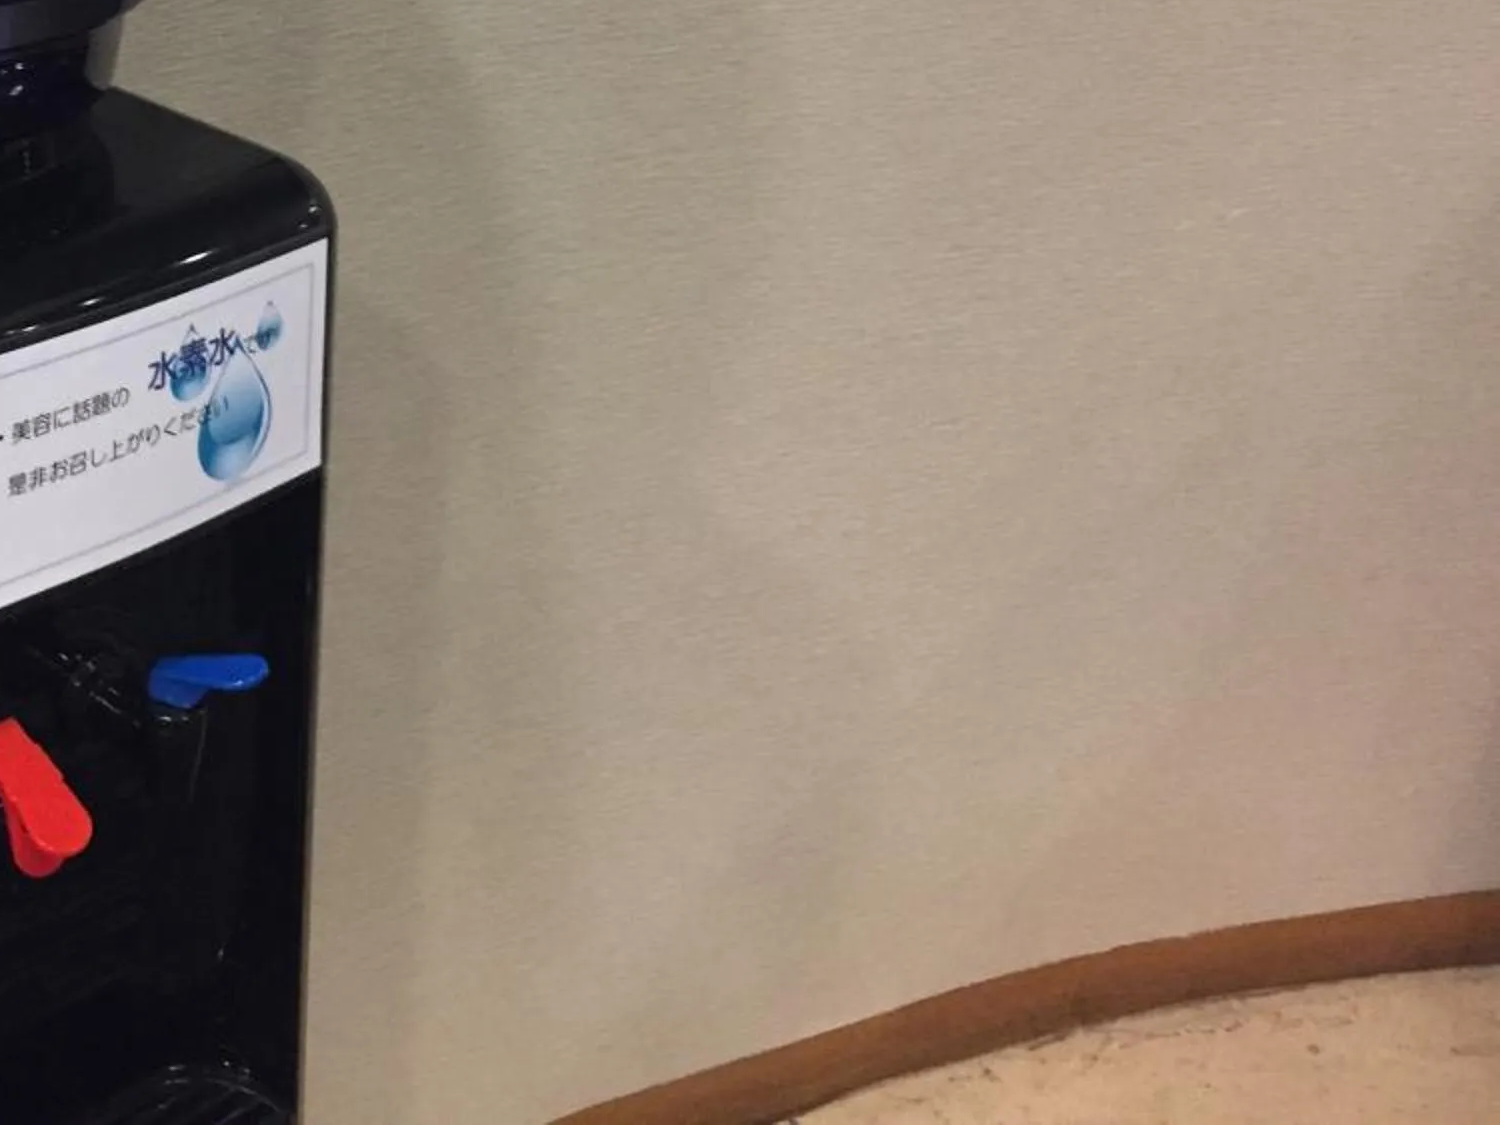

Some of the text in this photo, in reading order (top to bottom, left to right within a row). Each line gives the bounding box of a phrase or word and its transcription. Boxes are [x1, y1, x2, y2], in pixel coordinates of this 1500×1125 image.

[7, 394, 229, 497] 是非お召し上がりください
